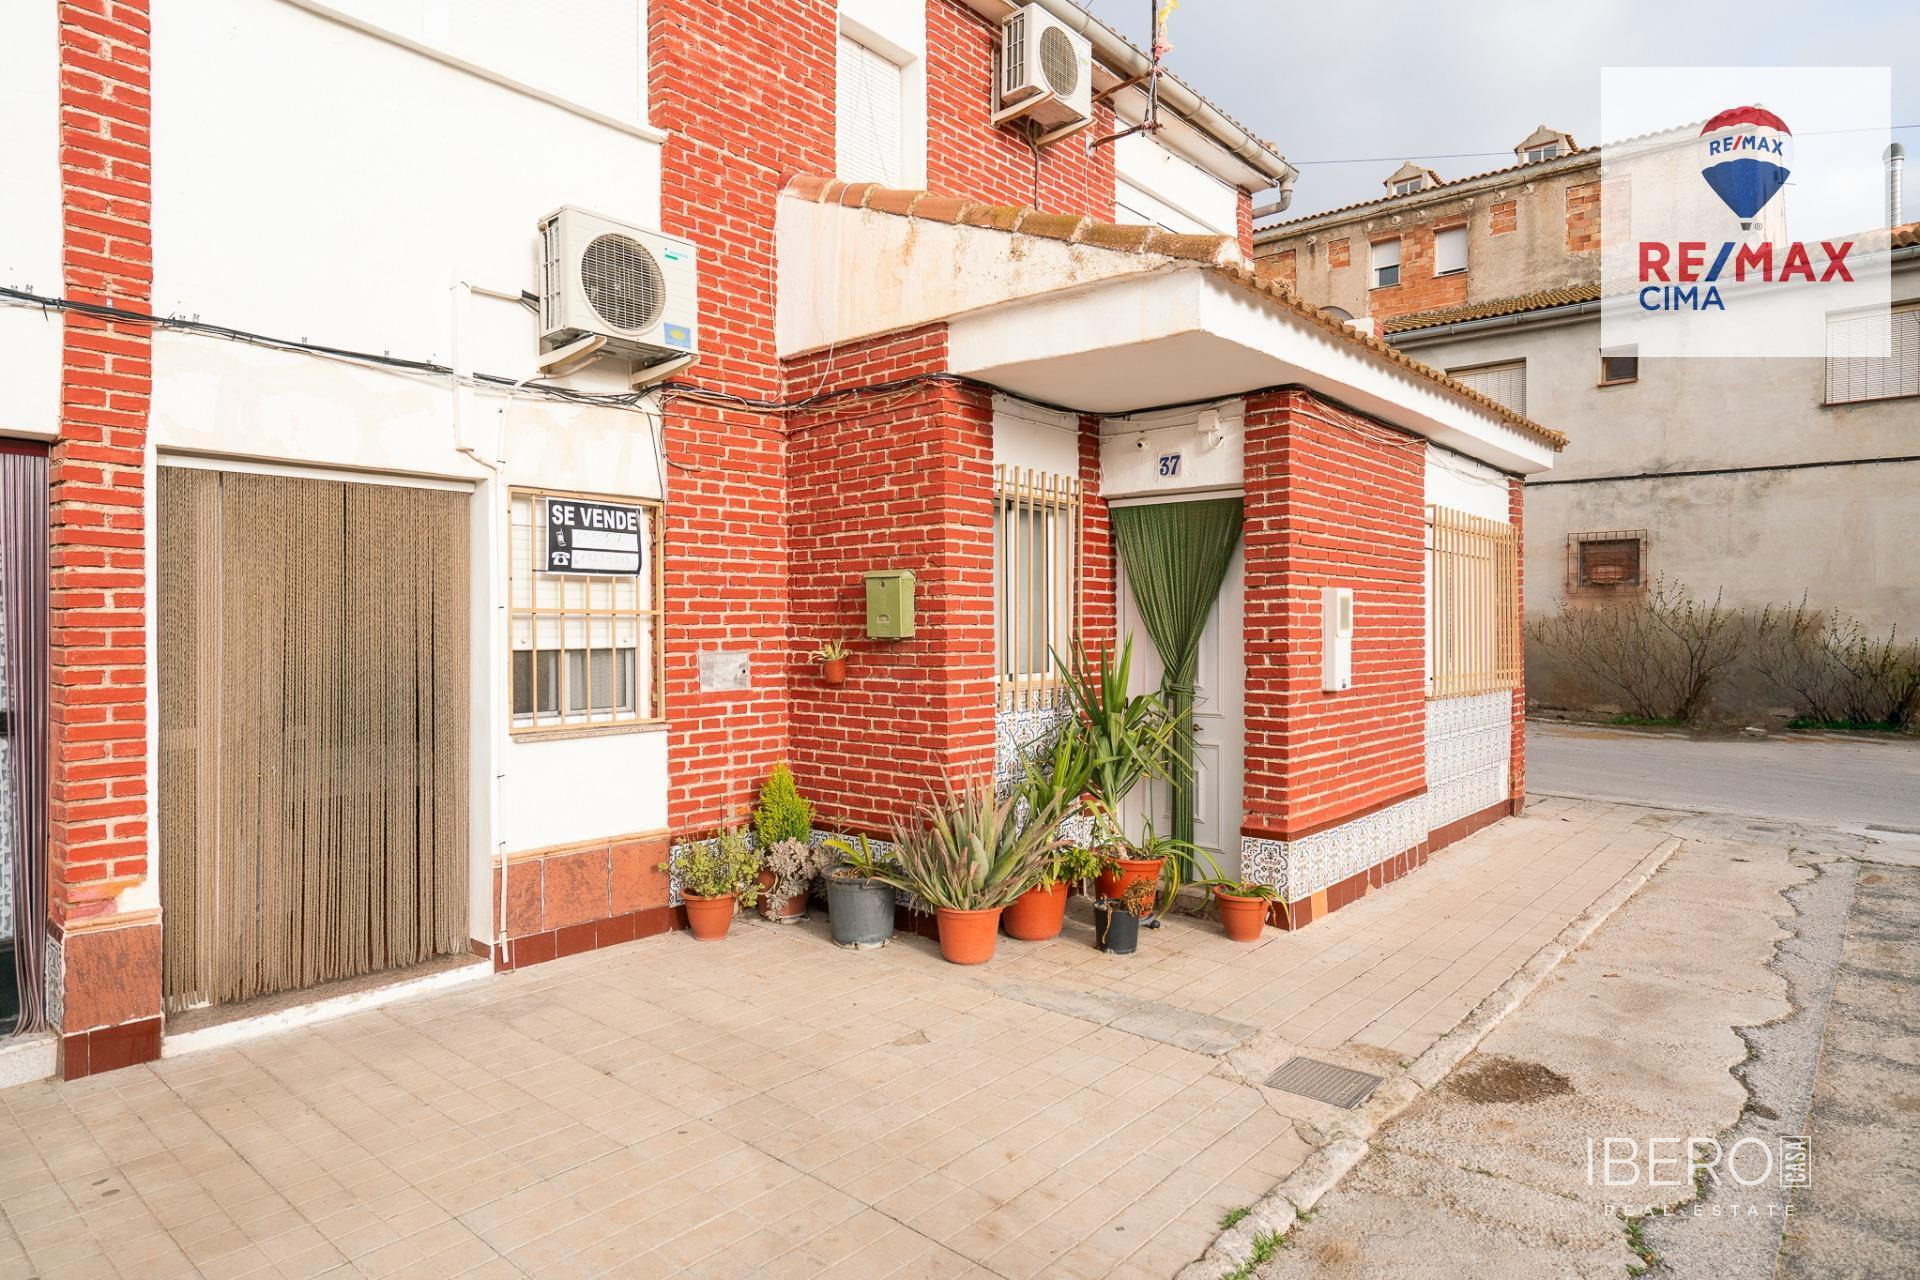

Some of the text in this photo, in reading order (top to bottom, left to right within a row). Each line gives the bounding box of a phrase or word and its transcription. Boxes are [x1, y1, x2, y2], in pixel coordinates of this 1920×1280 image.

[1159, 454, 1181, 476] 37
[551, 504, 638, 531] SE VENDE
